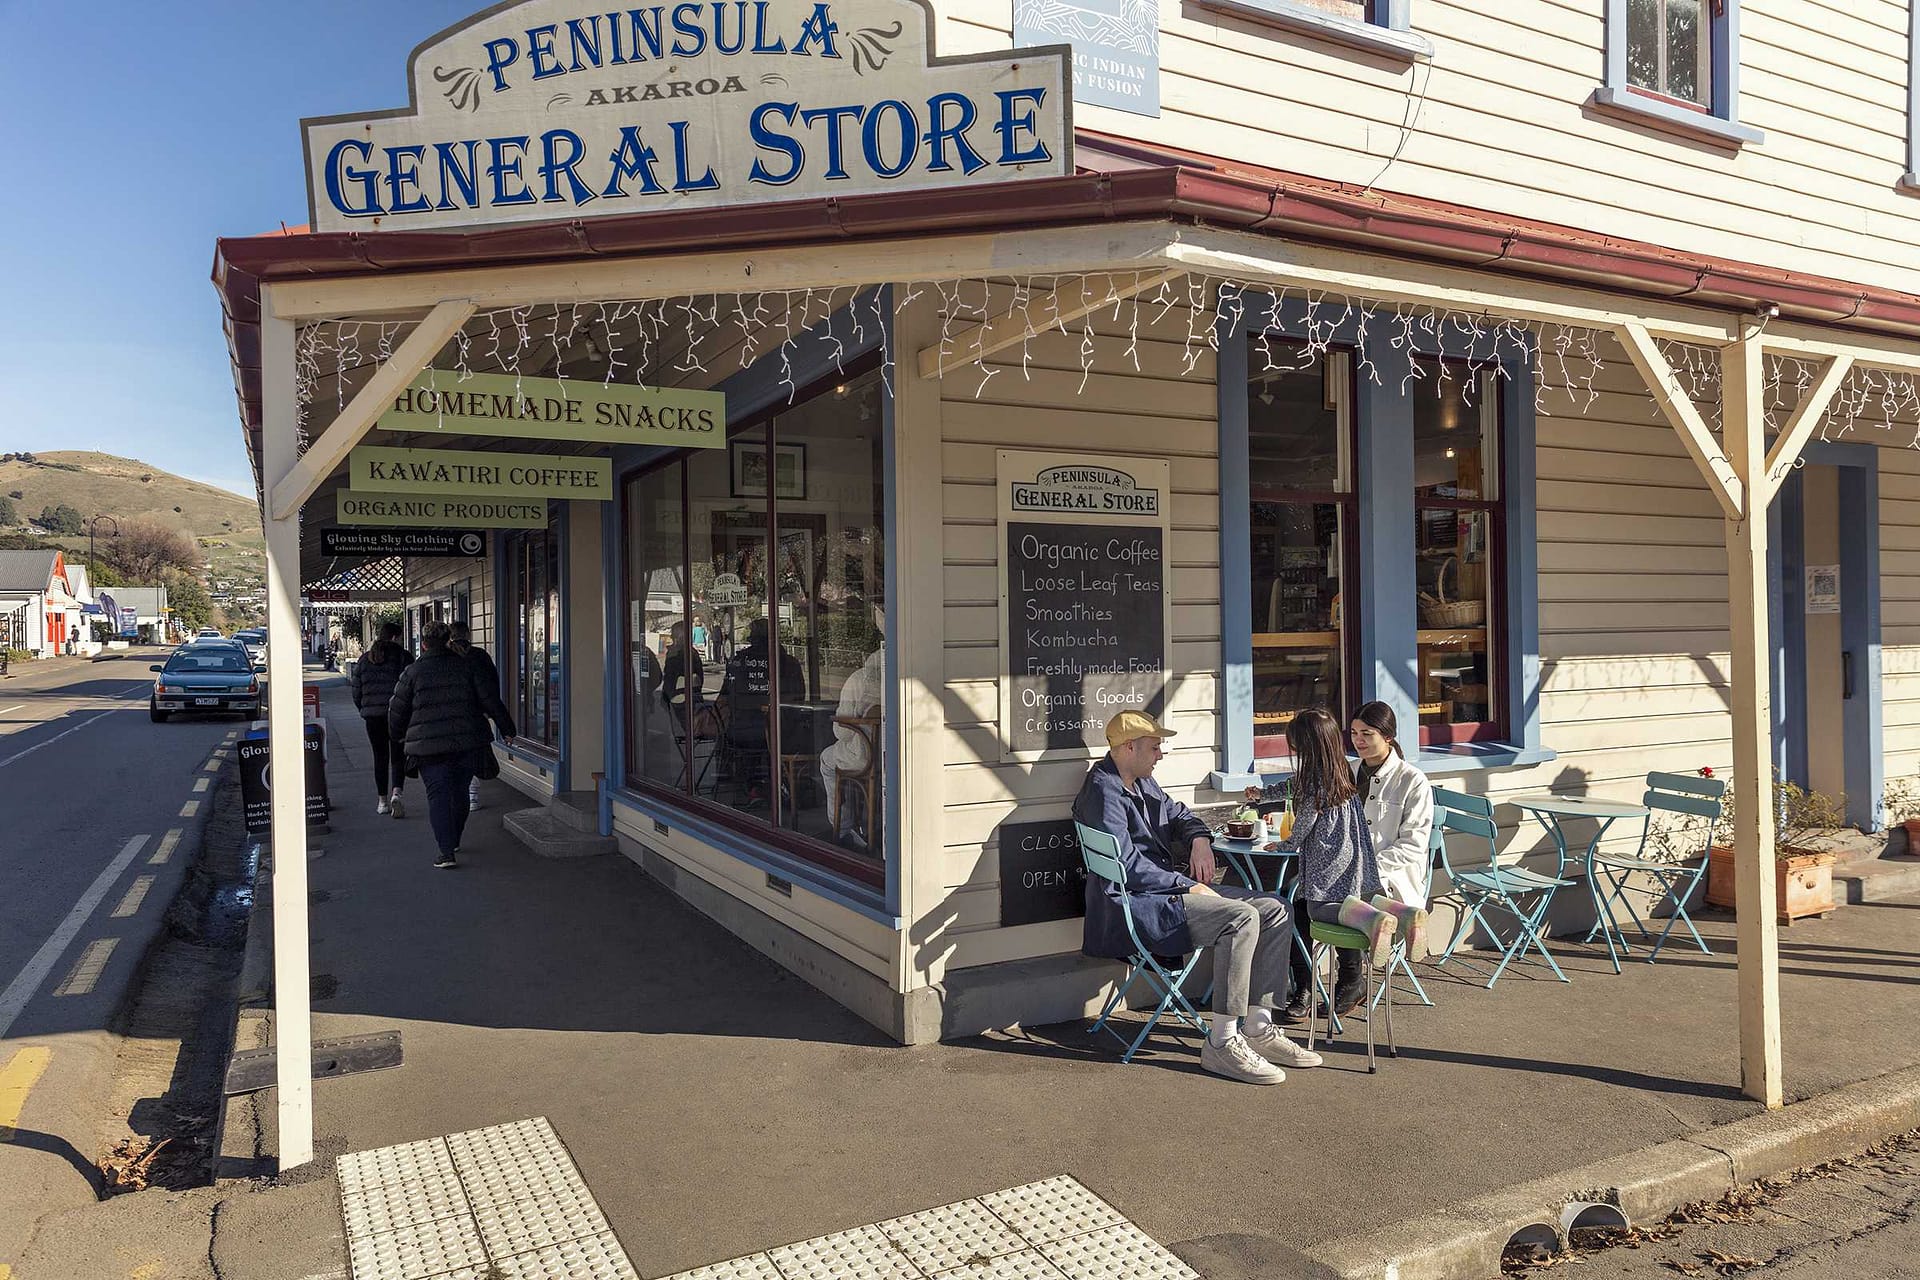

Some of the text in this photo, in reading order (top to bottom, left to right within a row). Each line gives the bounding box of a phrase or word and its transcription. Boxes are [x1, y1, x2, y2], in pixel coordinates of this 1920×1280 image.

[483, 1, 842, 92] PENINSULA
[1093, 57, 1145, 80] INDIAN
[585, 76, 748, 106] AKAROA
[1088, 75, 1142, 97] FUSION
[325, 87, 1053, 218] GENERAL STORE
[394, 388, 714, 432] HOMEMADE SNACKS
[369, 460, 599, 488] KAWATIRI COFFEE
[1052, 471, 1120, 486] PENINSULA
[343, 500, 542, 520] ORGANIC PRODUCTS
[1016, 488, 1155, 510] GENERAL STORE
[327, 534, 454, 545] Glowing Sky Clothing
[1021, 534, 1159, 569] Organic Coffee
[1022, 570, 1160, 596] Loose Leaf Teas
[1026, 599, 1113, 620] Smoothies
[1026, 628, 1118, 648] Kombucha
[1129, 657, 1160, 674] Food
[1022, 686, 1144, 715] Organic Goods
[1025, 714, 1104, 733] Croissants
[1023, 870, 1067, 888] OPEN
